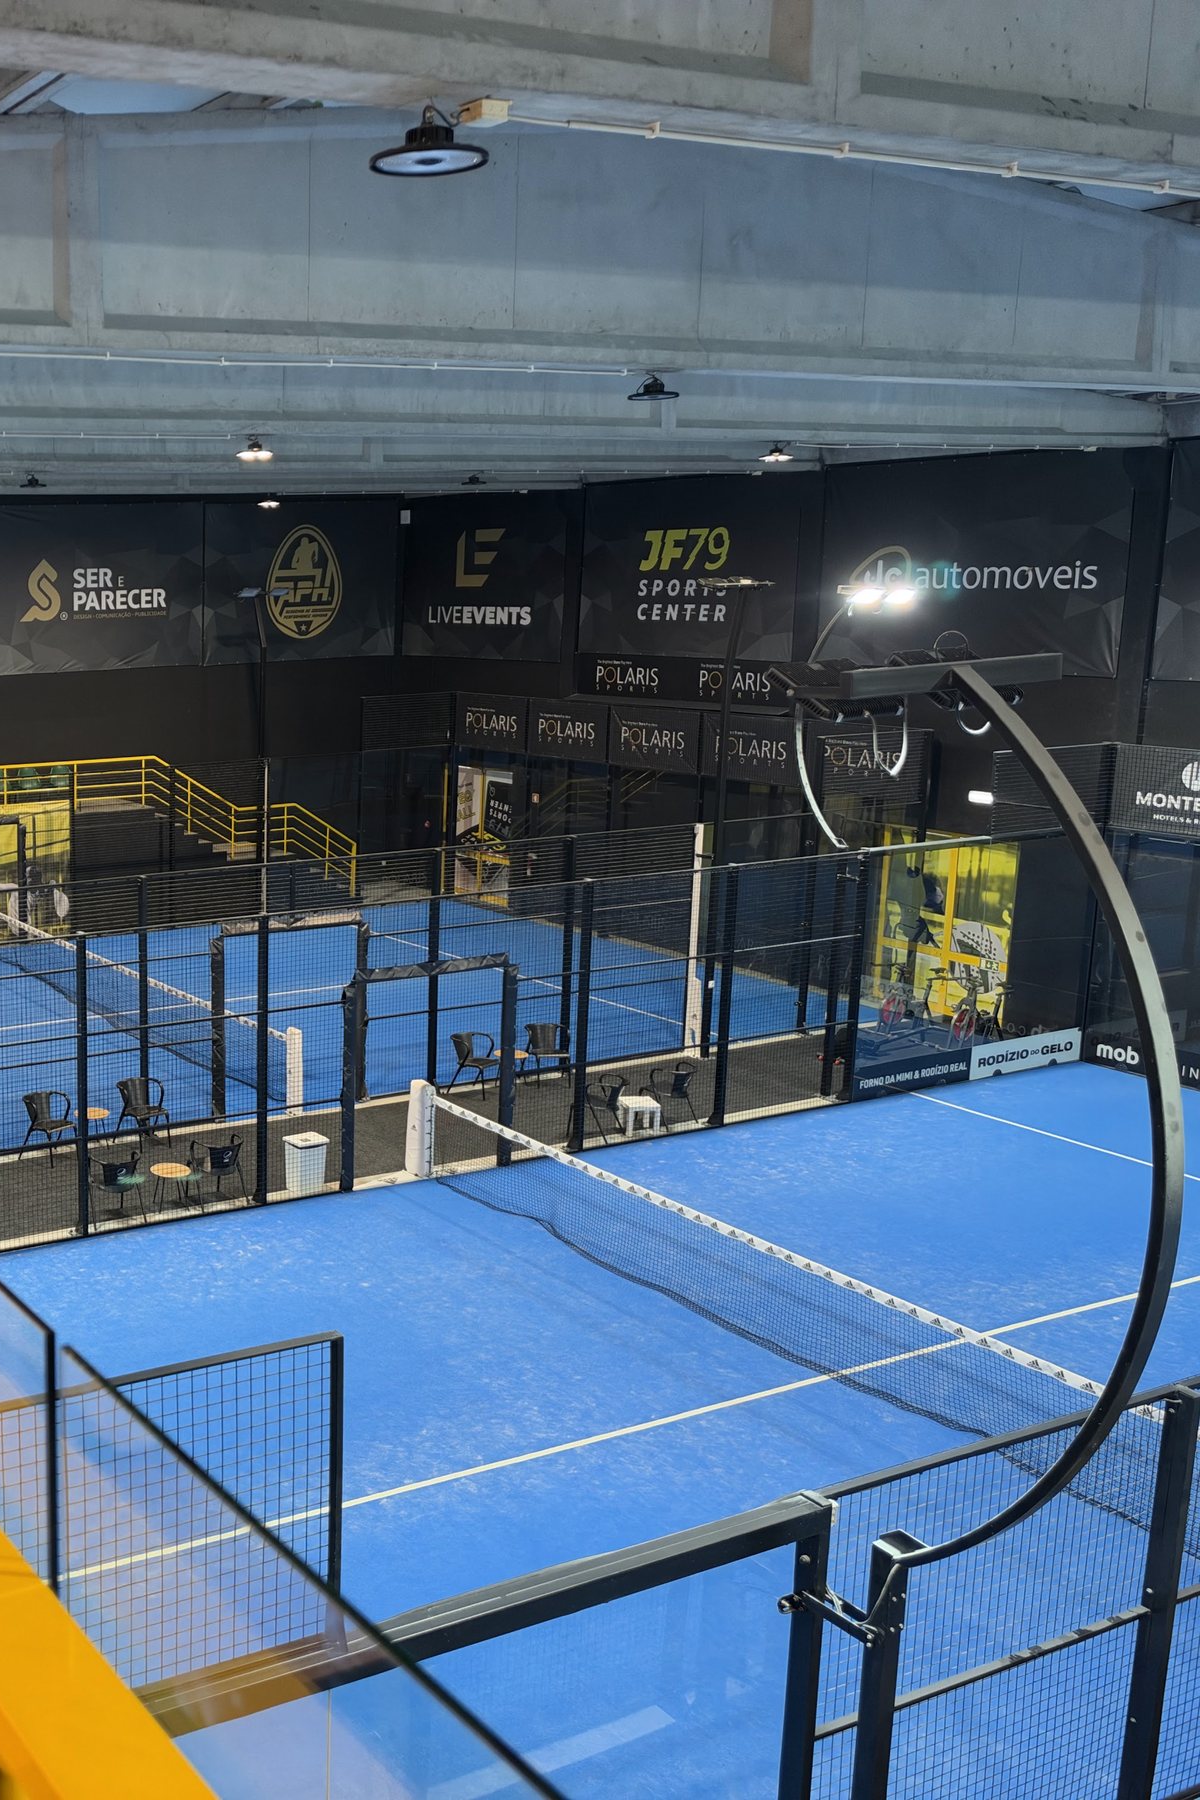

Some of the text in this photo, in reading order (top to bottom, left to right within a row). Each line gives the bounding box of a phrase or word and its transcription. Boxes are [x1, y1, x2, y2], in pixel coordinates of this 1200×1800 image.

[638, 527, 730, 571] JF79
[73, 567, 125, 589] SER E
[916, 560, 1098, 590] automoveis
[73, 588, 167, 611] PARECER
[428, 605, 532, 626] LIVEEVENTS
[637, 603, 726, 622] CENTER
[596, 666, 659, 686] POLARIS
[699, 670, 771, 692] POARIS
[596, 684, 658, 694] SPORTS
[699, 689, 769, 700] SPRTS
[466, 712, 517, 732] POLARIS
[538, 719, 595, 740] POLARIS
[466, 728, 517, 739] SPORTS
[538, 735, 594, 747] SPORTS
[621, 726, 685, 750] POLARIS
[1153, 814, 1184, 823] HOTELS
[977, 1041, 1074, 1068] RODÍZIO DO GELO
[1096, 1043, 1139, 1065] mob
[859, 1061, 968, 1089] FORNO DA MIMI & RODÍZIO REAL
